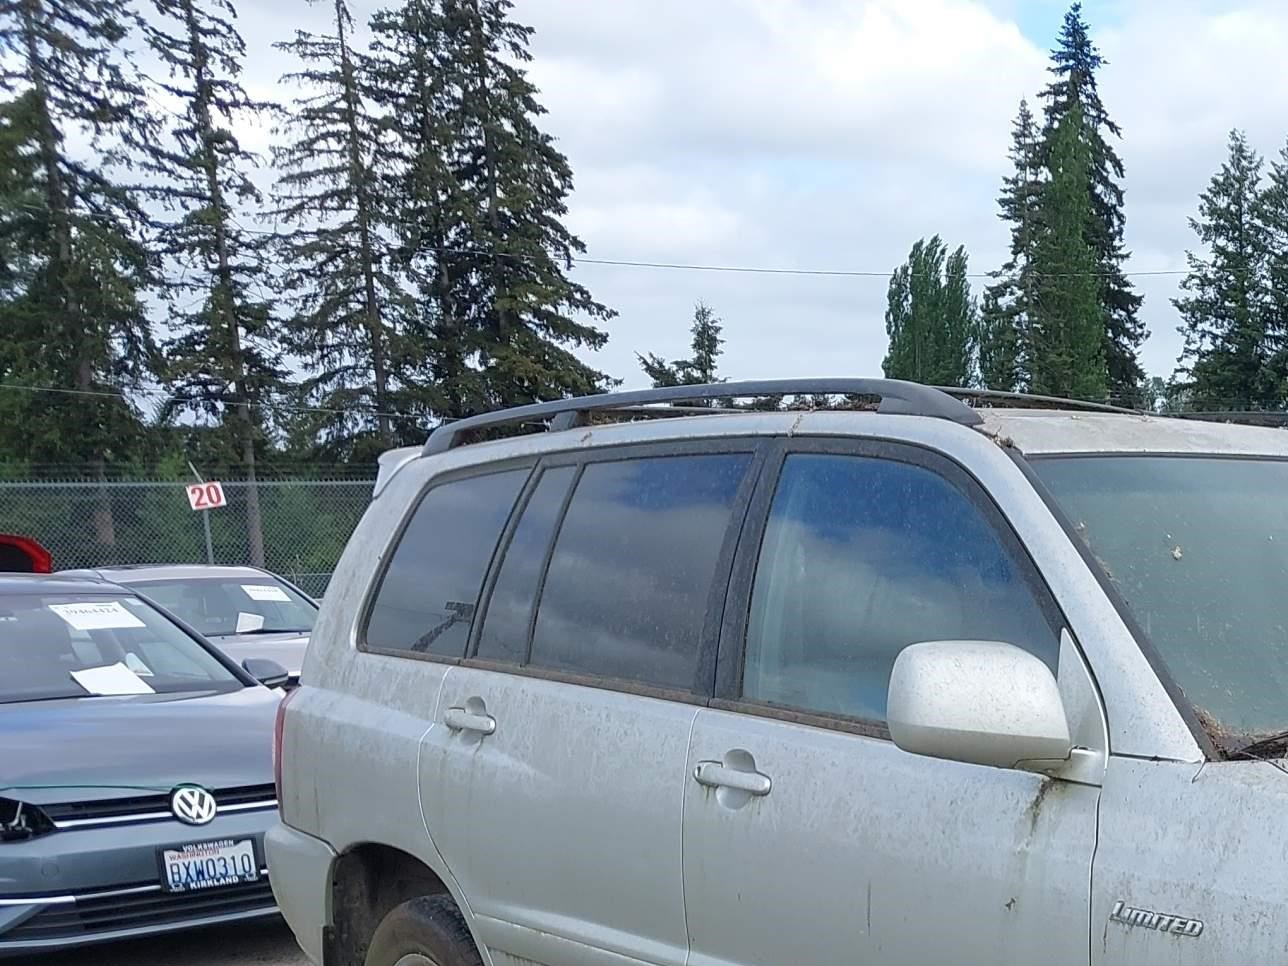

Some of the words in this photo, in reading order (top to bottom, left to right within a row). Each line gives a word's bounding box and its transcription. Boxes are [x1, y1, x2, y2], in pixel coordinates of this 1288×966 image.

[190, 484, 222, 507] 20
[182, 839, 235, 852] VOLKSWAGEN
[170, 853, 253, 886] BXW0310
[189, 875, 240, 890] KIRKLAND
